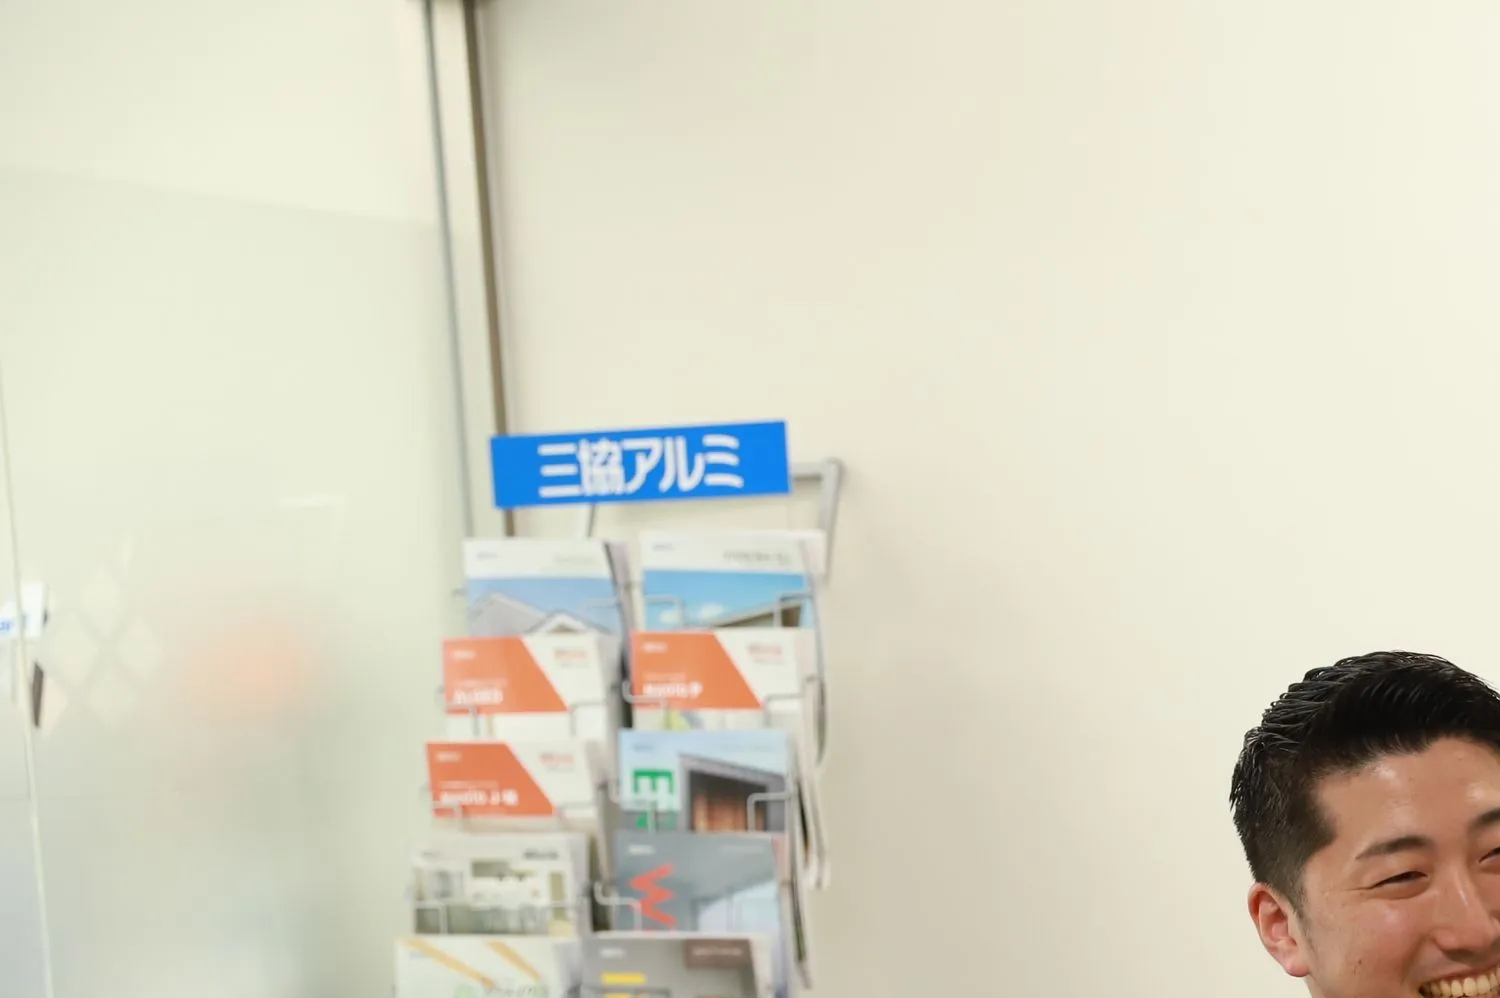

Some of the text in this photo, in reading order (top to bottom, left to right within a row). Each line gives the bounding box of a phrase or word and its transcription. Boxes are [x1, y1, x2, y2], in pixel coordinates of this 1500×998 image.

[537, 433, 744, 498] 三協アルミ
